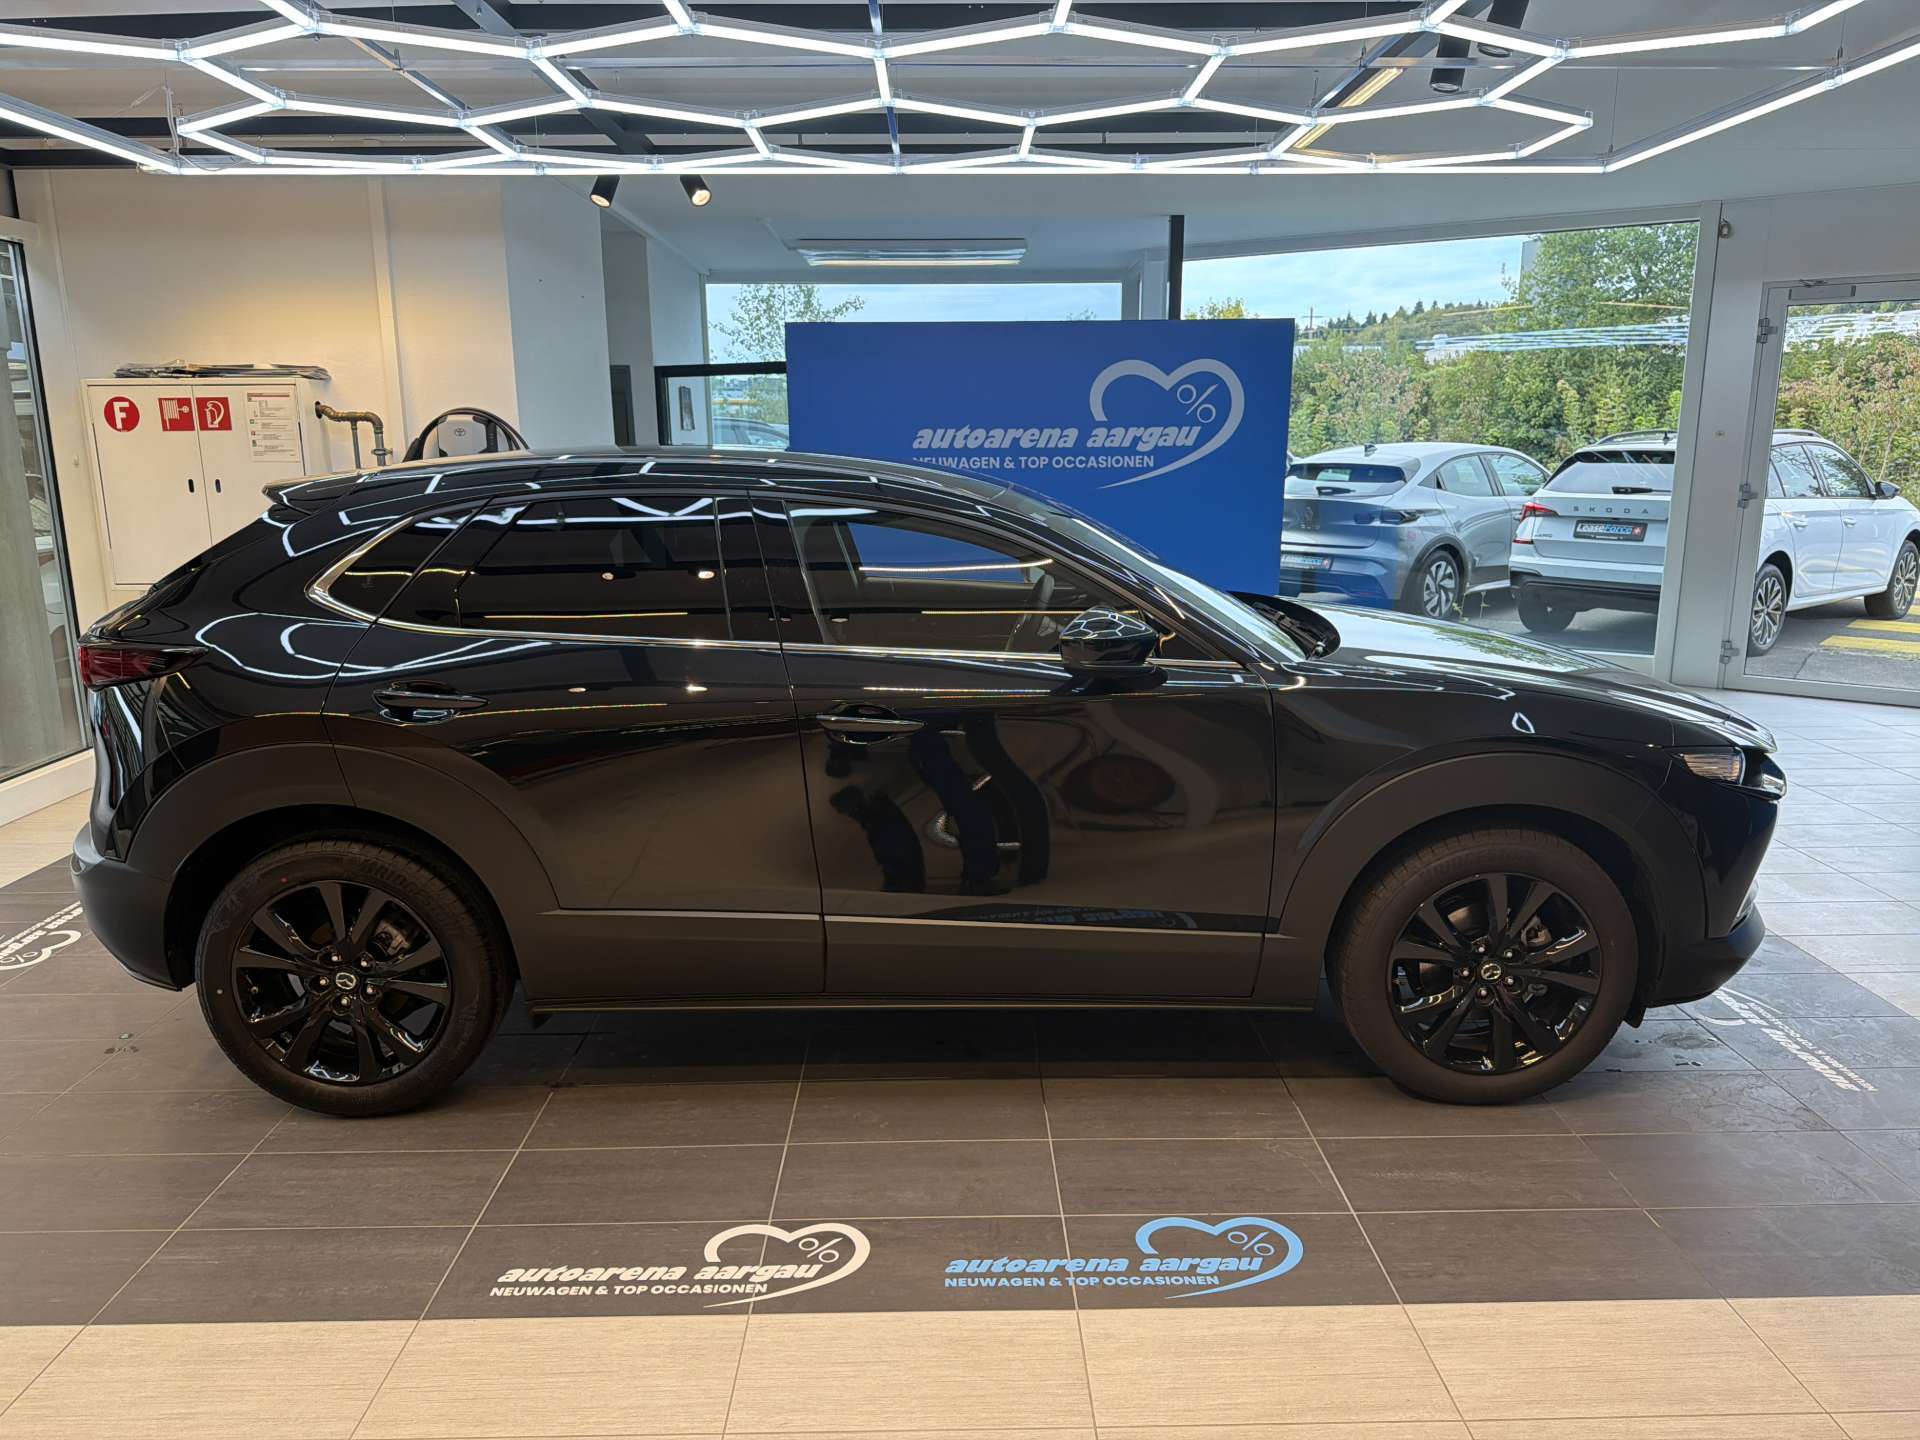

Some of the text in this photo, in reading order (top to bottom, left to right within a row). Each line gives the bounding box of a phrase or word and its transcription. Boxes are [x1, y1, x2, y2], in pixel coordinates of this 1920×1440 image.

[113, 401, 130, 429] F
[912, 423, 1201, 452] autoarena aargau
[1003, 456, 1016, 469] &
[1019, 456, 1049, 469] TOP
[1055, 455, 1154, 469] OCCASIONEN
[497, 1263, 824, 1283] autoarena aargau
[944, 1256, 1264, 1274] autoarena aargau
[489, 1283, 768, 1297] NEUWAGEN & TOP OCCASIONEN
[944, 1275, 1220, 1288] NEUWAGEN & TOP OCCASIONEN
